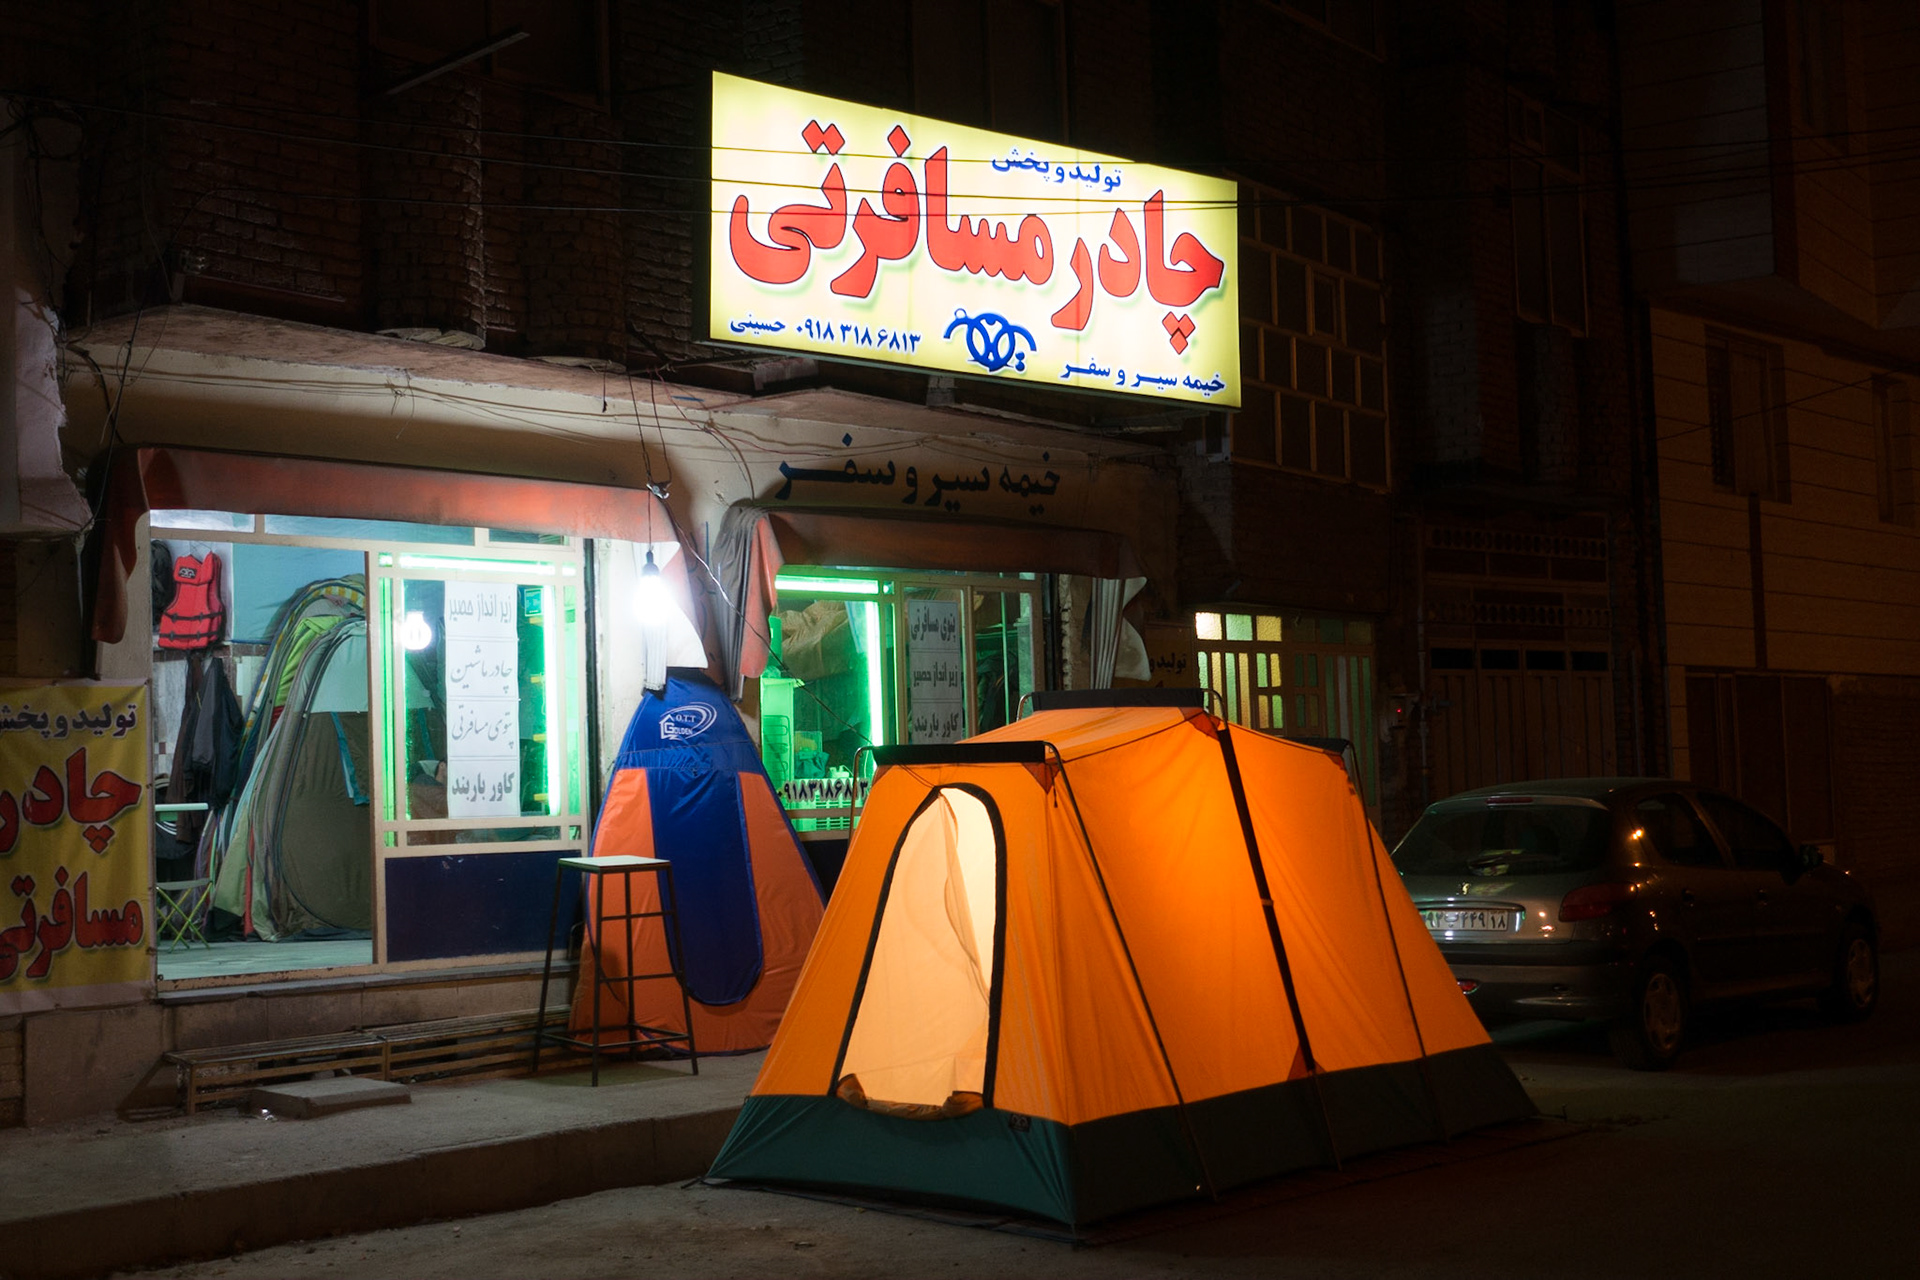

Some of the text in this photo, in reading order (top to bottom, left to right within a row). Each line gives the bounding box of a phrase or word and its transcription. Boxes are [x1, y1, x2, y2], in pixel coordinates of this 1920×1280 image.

[992, 148, 1050, 182] پخش
[730, 119, 1224, 355] چادر مسافرتی
[730, 314, 786, 335] حسینی
[1060, 357, 1226, 397] خیمه سیر و سفر
[775, 432, 1061, 515] خیمه سیر و سفر
[53, 715, 68, 738] و
[72, 703, 137, 736] تولید
[777, 780, 869, 800] ۰۹۱۸۳۱۸۶۸۳
